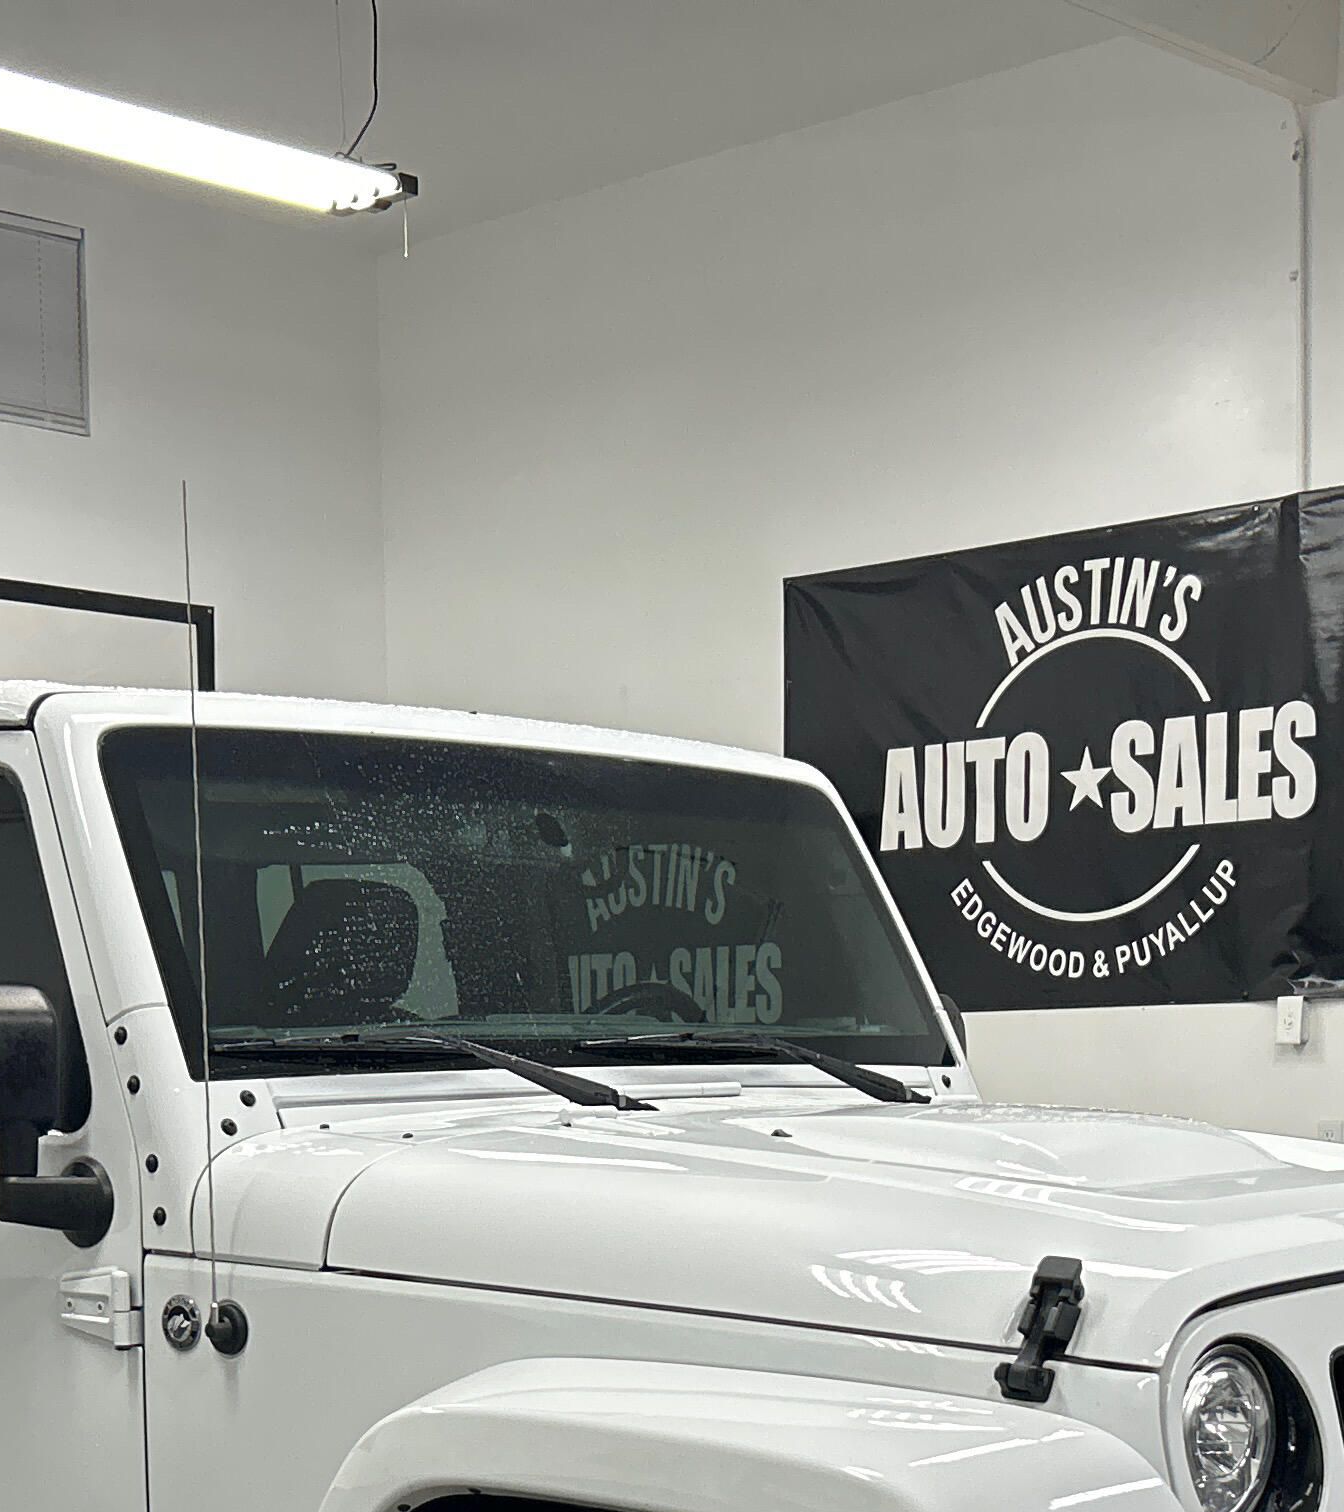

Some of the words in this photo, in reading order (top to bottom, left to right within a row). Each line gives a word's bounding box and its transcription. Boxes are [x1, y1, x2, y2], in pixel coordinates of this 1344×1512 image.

[994, 556, 1202, 667] AUSTIN'S
[879, 731, 1050, 851] AUTO
[1110, 700, 1317, 833] SALES
[950, 877, 1084, 978] EDGEWOOD
[1092, 955, 1110, 977] &
[1115, 858, 1238, 975] PUYALLUP
[669, 942, 783, 1024] SALES
